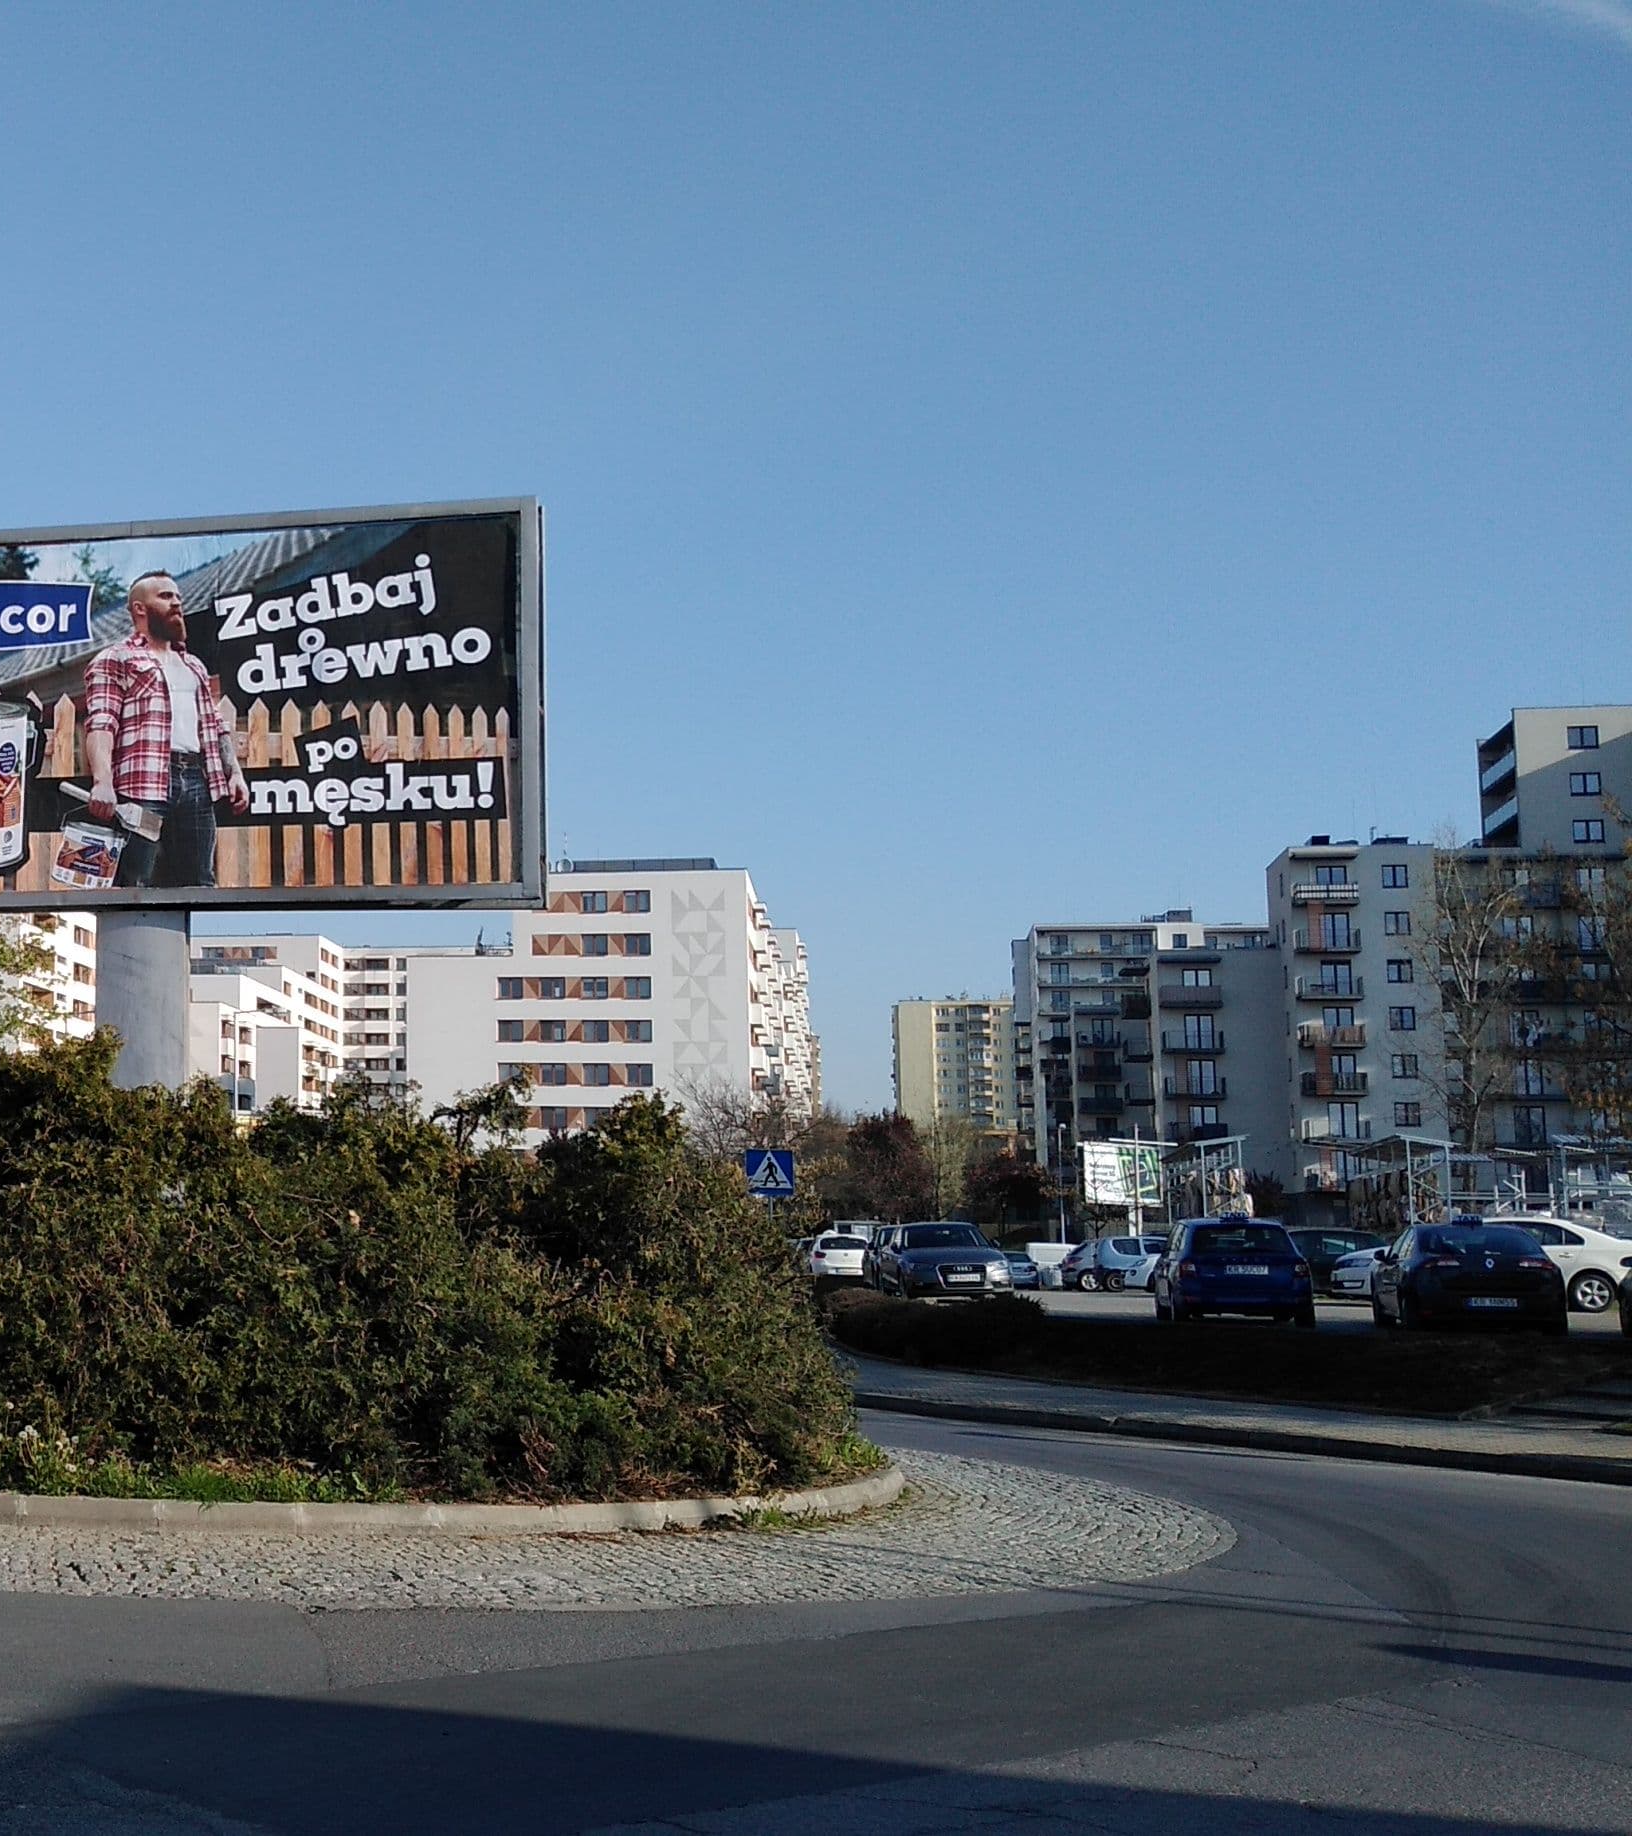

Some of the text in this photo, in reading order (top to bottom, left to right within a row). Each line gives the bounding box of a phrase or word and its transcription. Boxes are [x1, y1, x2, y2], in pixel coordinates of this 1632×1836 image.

[214, 553, 436, 641] Zadbaj
[237, 626, 491, 694] drewno
[297, 627, 326, 653] o
[304, 736, 358, 773] po
[250, 761, 494, 826] męsku!
